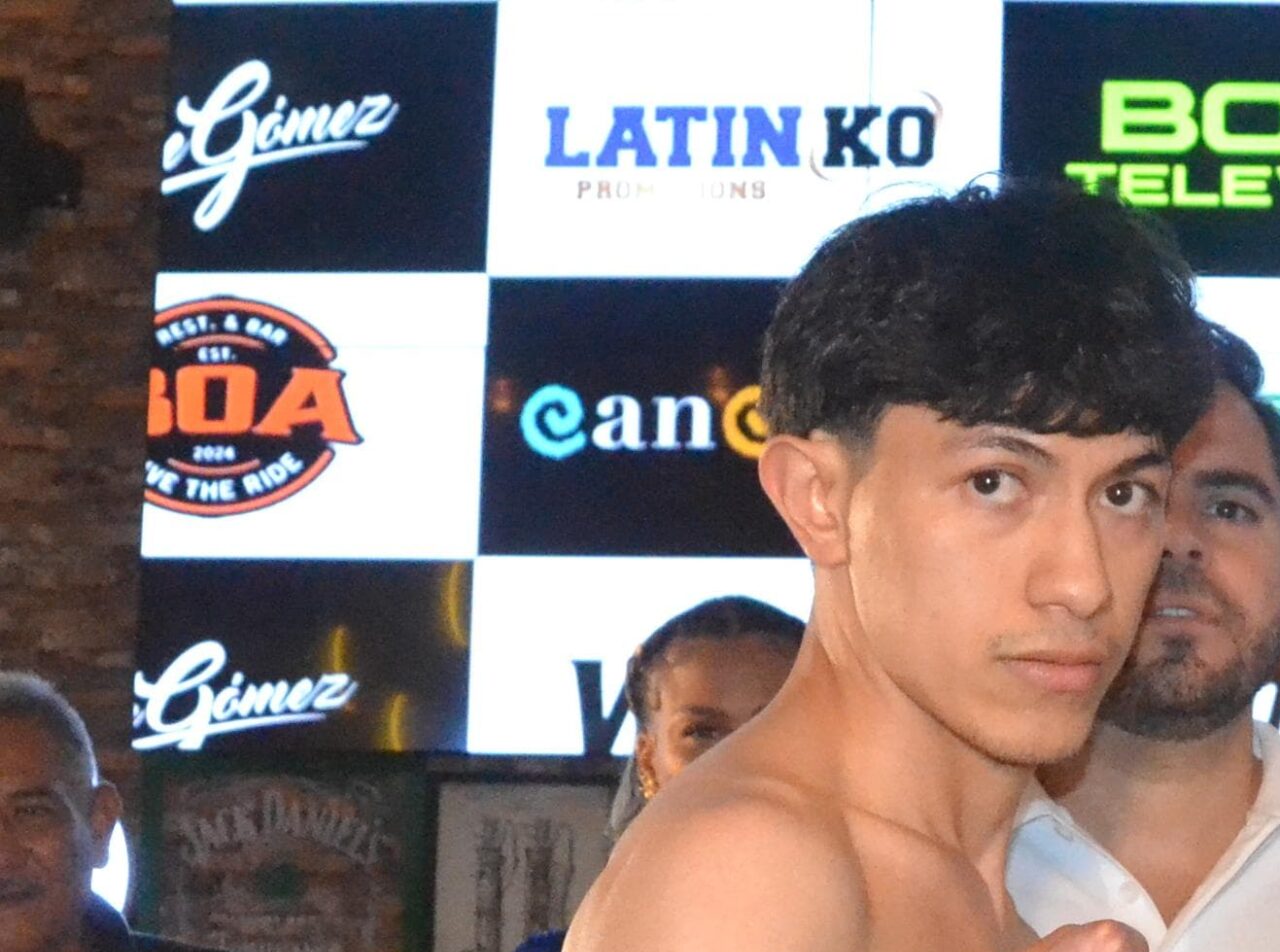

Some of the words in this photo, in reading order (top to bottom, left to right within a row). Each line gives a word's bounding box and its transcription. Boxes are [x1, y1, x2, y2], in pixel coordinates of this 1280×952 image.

[545, 106, 801, 168] LATIN
[822, 106, 935, 168] KO
[577, 180, 766, 200] PROMIONS
[186, 477, 237, 501] THE
[242, 451, 304, 495] RIDE
